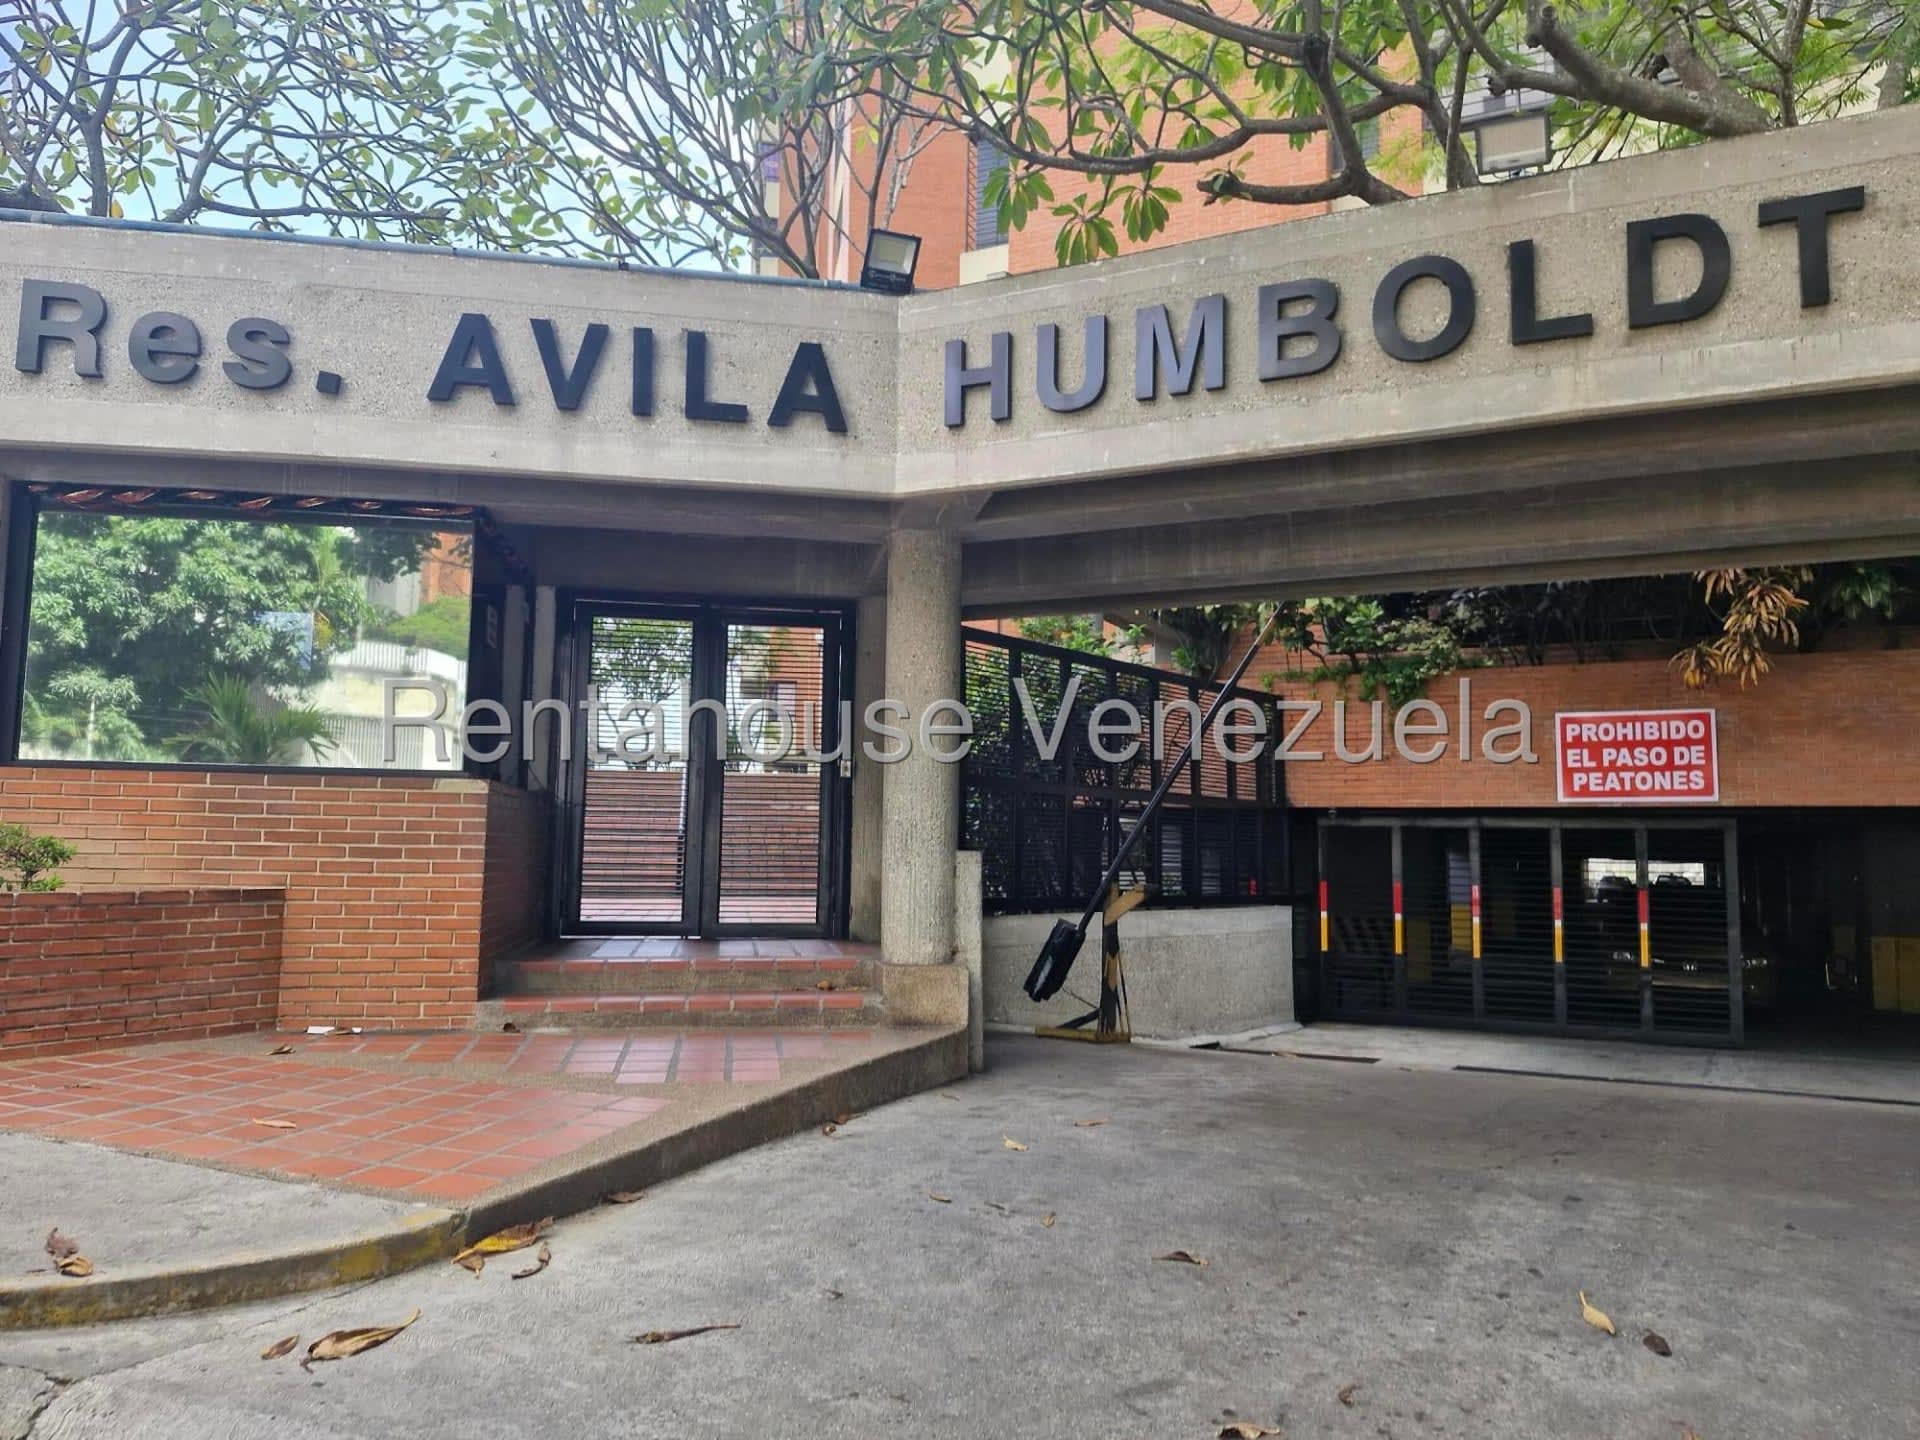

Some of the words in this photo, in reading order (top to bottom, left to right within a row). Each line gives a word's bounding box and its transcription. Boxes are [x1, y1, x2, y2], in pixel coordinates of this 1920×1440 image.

[943, 185, 1866, 428] HUMBOLDT
[15, 278, 345, 397] Res.
[427, 312, 849, 433] AVILA
[1566, 719, 1705, 742] PROHIBIDO
[1567, 749, 1597, 768] EL
[1602, 747, 1667, 767] PASO
[1673, 745, 1706, 766] DE
[1573, 770, 1705, 791] PEATONES
